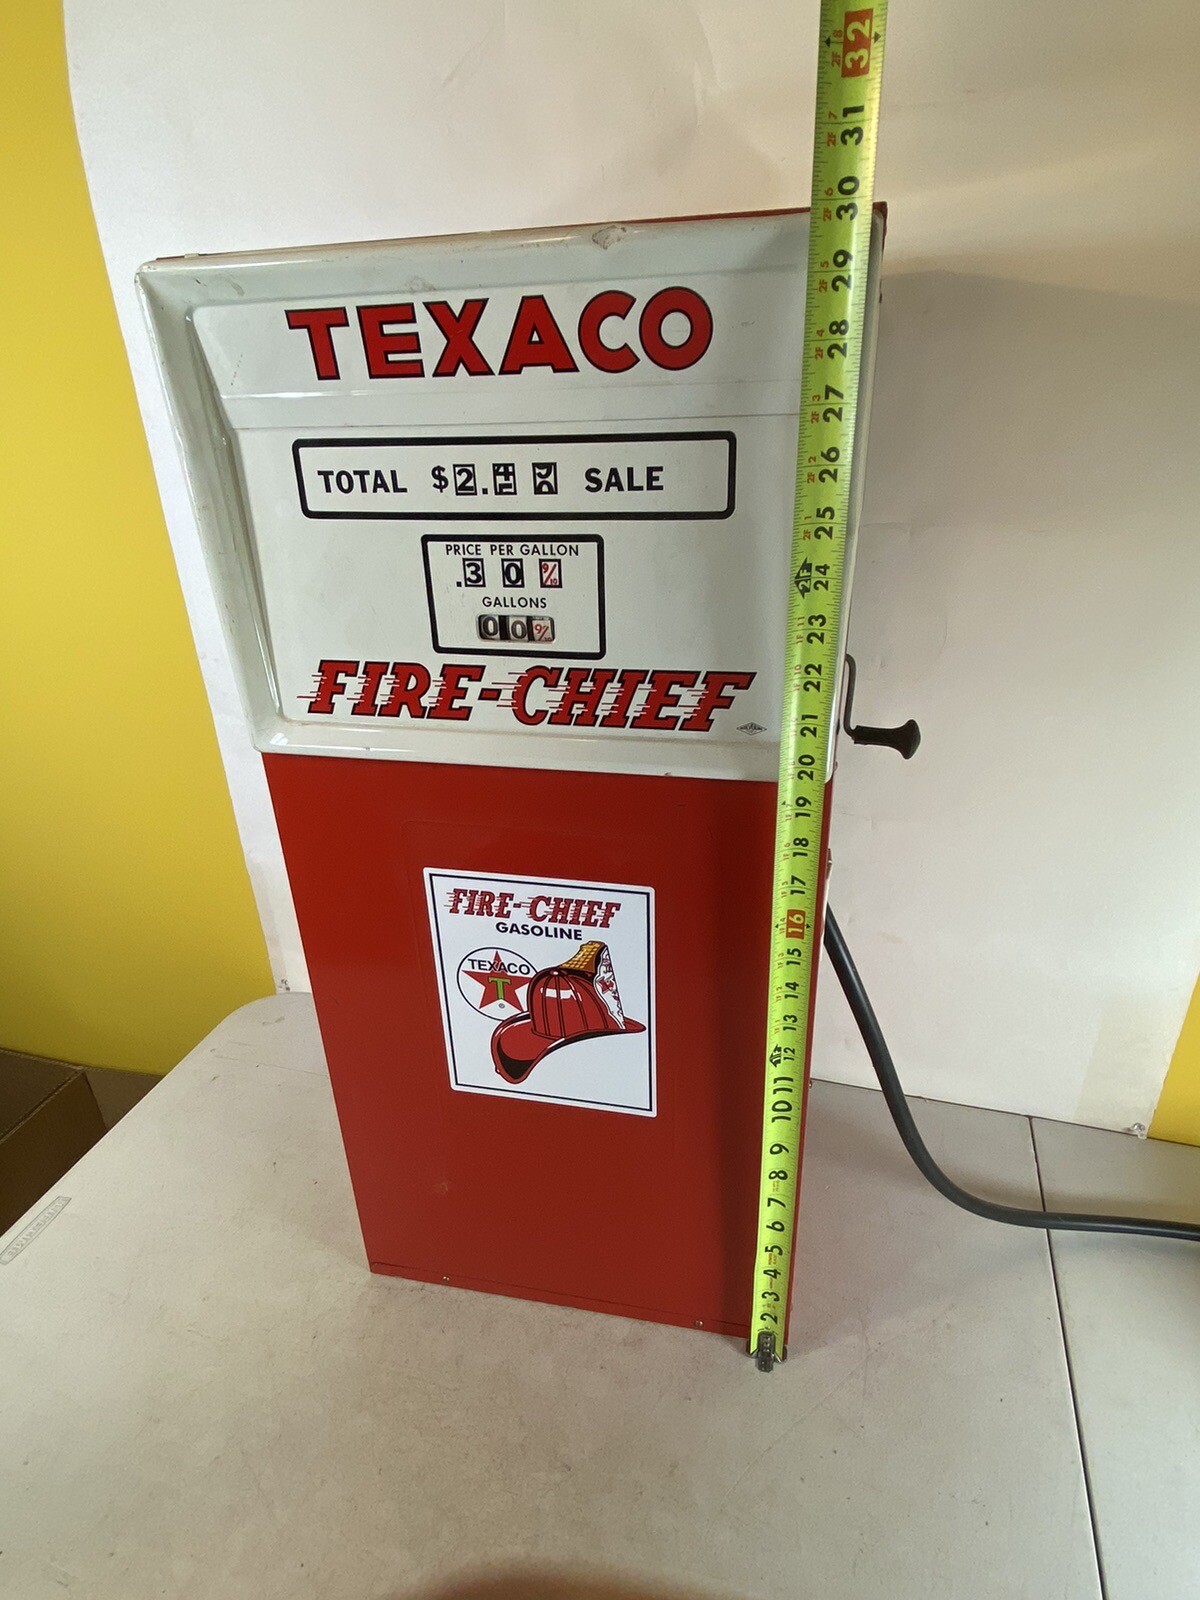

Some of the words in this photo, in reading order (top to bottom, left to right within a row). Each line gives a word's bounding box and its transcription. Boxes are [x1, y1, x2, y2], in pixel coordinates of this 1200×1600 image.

[845, 19, 870, 69] 32
[841, 105, 864, 146] 31
[836, 176, 860, 221] 30
[823, 207, 832, 221] 2F
[832, 249, 853, 292] 29
[818, 279, 827, 292] 2F
[285, 286, 713, 380] TEXACO
[827, 319, 849, 359] 28
[815, 347, 823, 359] 2F
[823, 384, 844, 422] 27
[811, 411, 819, 424] 2F
[818, 446, 840, 483] 26
[317, 469, 407, 494] TOTAL
[584, 466, 664, 492] SALE
[807, 472, 815, 483] 2F
[814, 506, 835, 540] 25
[803, 529, 811, 540] 2F
[446, 544, 481, 555] PRICE
[490, 544, 514, 556] PER
[520, 544, 579, 556] GALLON
[813, 563, 830, 591] 24
[482, 597, 547, 608] GALLONS
[807, 614, 827, 644] 23
[803, 663, 822, 692] 22
[303, 659, 757, 732] FIRE-CHIEF
[800, 714, 818, 738] 21
[797, 754, 815, 780] 20
[795, 796, 812, 818] 19
[793, 838, 809, 857] 18
[790, 875, 806, 895] 17
[446, 888, 621, 928] FIRE-CHIEF
[495, 922, 582, 940] GASOLINE
[788, 914, 804, 933] 16
[468, 958, 531, 975] TEXACO
[786, 948, 802, 966] 15
[488, 977, 511, 1000] T
[785, 981, 799, 999] 14
[783, 1014, 798, 1031] 13
[783, 1047, 795, 1061] 12
[773, 1076, 793, 1095] 11
[771, 1100, 792, 1123] 10
[770, 1143, 789, 1155] 9
[768, 1170, 788, 1180] 8
[767, 1198, 786, 1208] 7
[766, 1221, 784, 1232] 6
[765, 1245, 783, 1256] 5
[763, 1268, 781, 1279] 4
[762, 1291, 779, 1302] 3
[760, 1313, 777, 1324] 2
